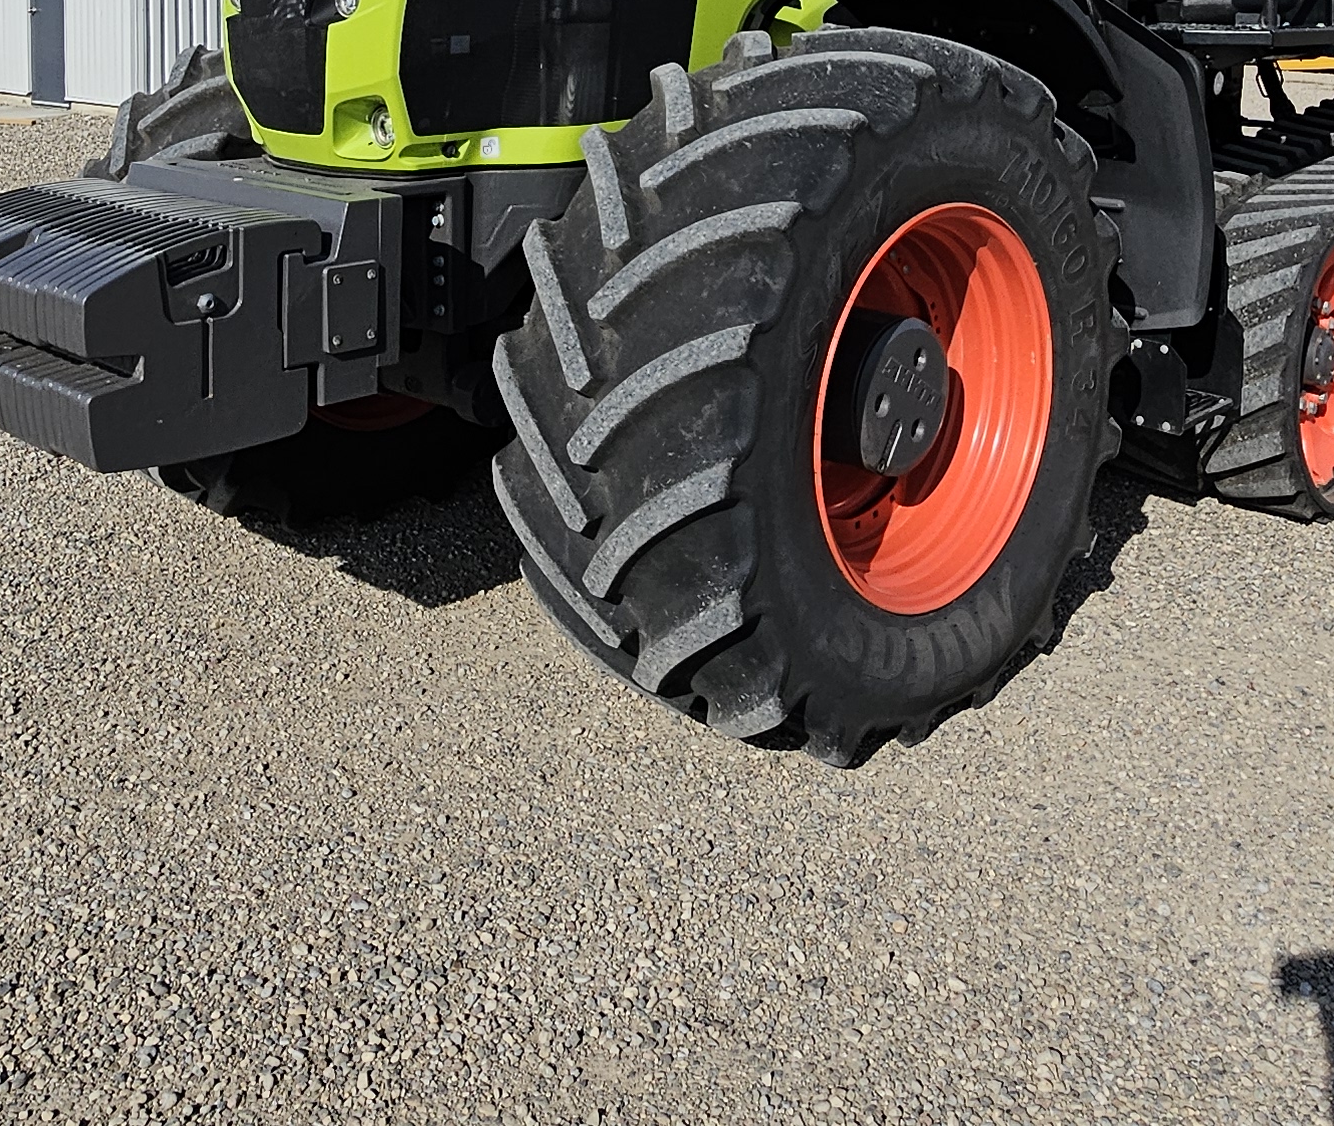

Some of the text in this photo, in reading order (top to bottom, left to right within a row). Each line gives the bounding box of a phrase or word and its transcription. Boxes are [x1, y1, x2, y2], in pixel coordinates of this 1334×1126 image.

[998, 139, 1096, 437] 710/60 R 34
[830, 562, 1014, 697] Mitas
